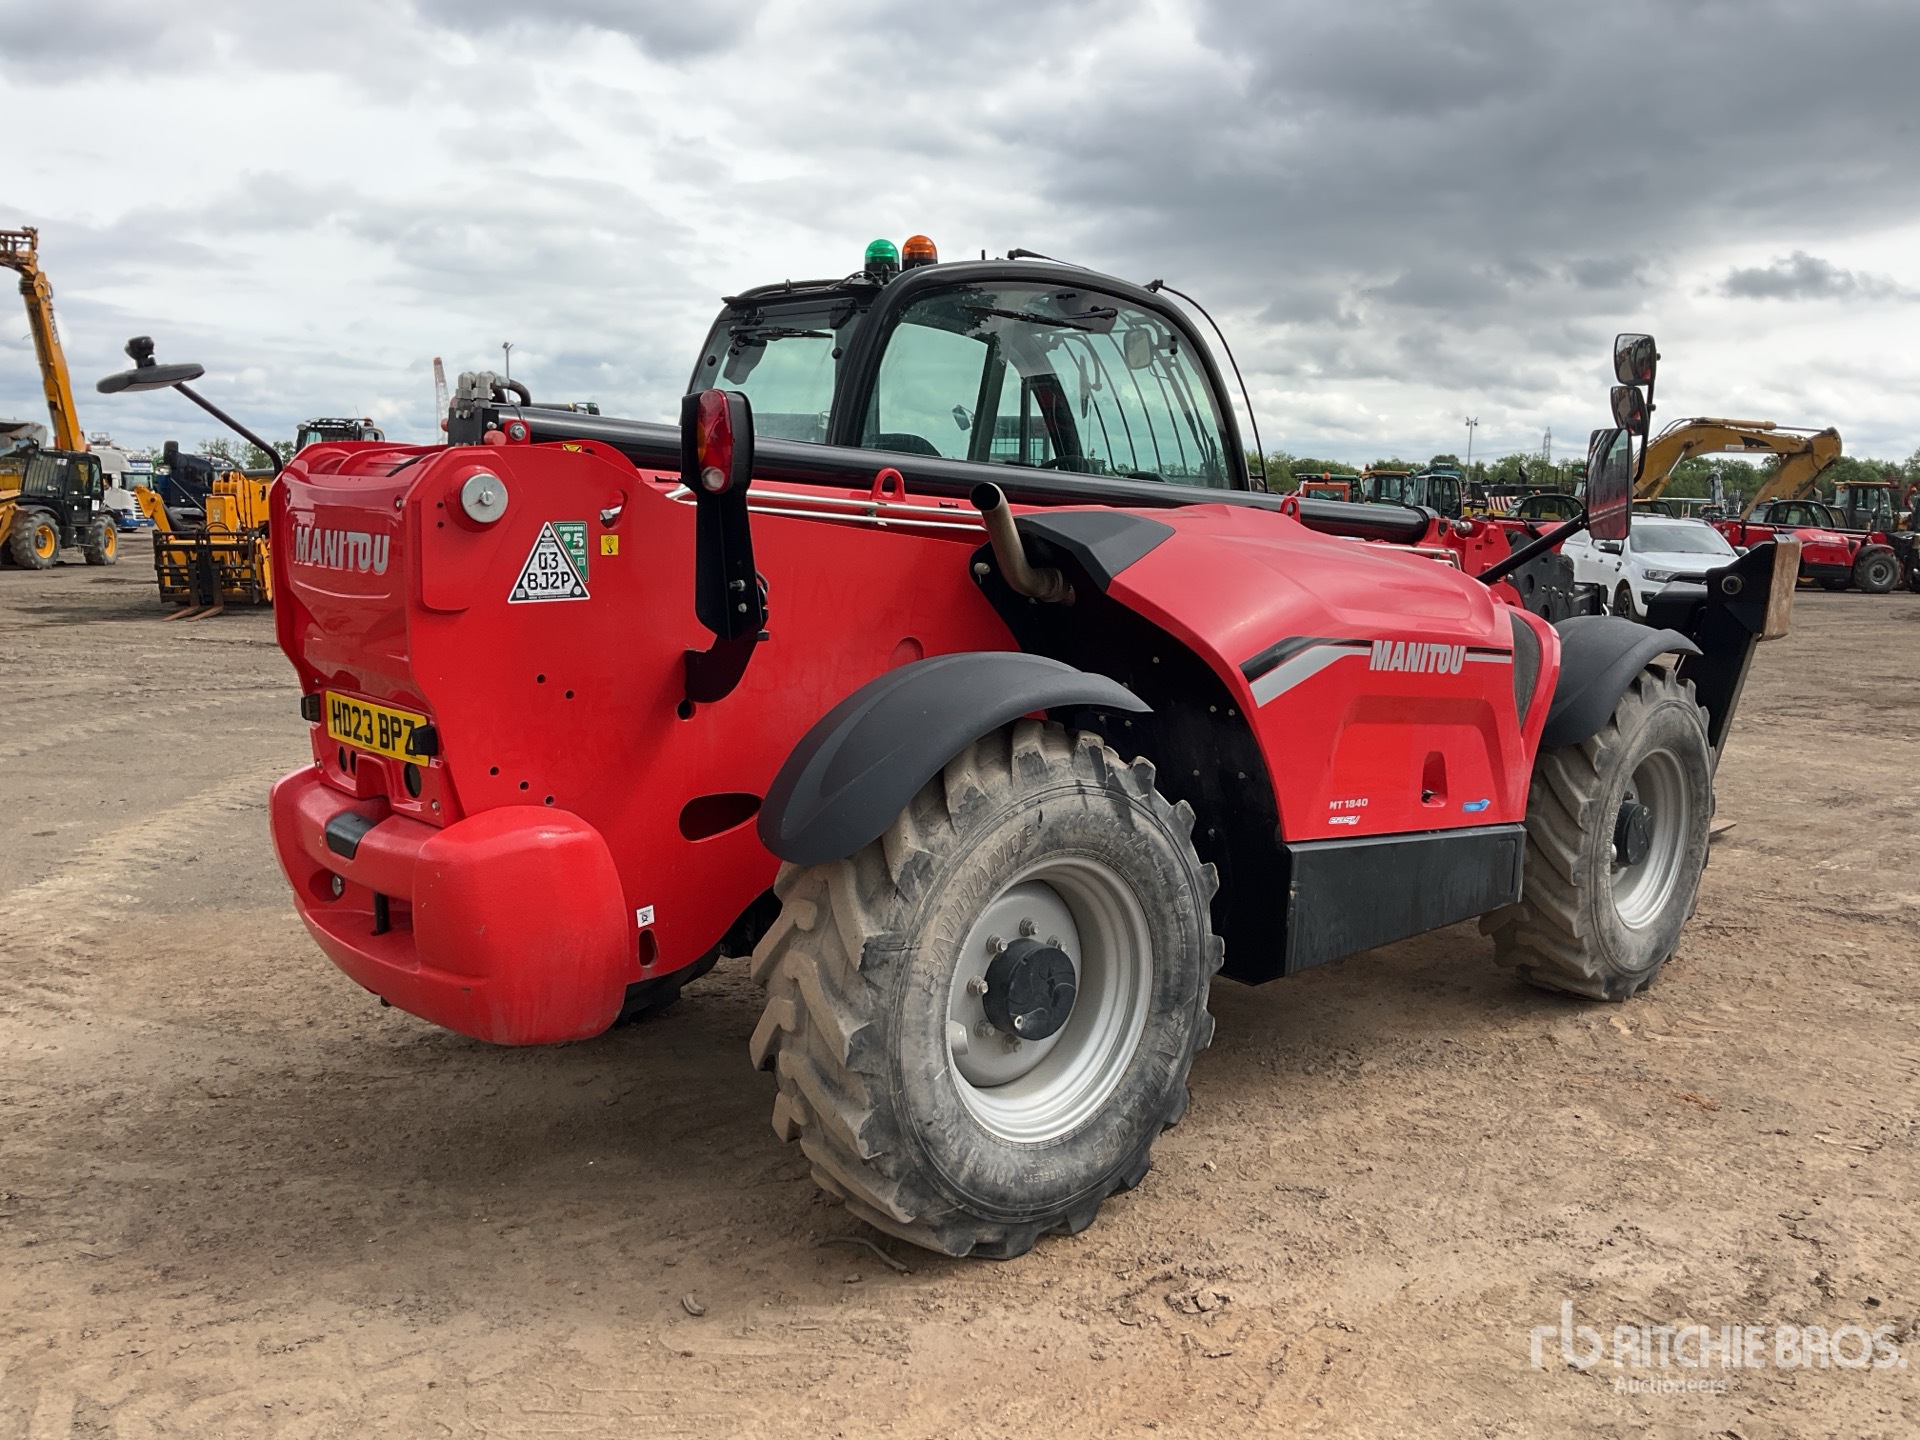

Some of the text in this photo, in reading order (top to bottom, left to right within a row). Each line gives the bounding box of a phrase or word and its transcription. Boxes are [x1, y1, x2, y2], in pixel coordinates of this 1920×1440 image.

[295, 525, 390, 573] MANITOU
[573, 532, 584, 548] 5
[527, 571, 570, 590] BJ2P
[1369, 639, 1466, 675] MANITOU
[331, 698, 416, 756] HD23 BPZ
[1329, 797, 1369, 810] MT 1840
[931, 823, 1033, 968] ALLIANCE
